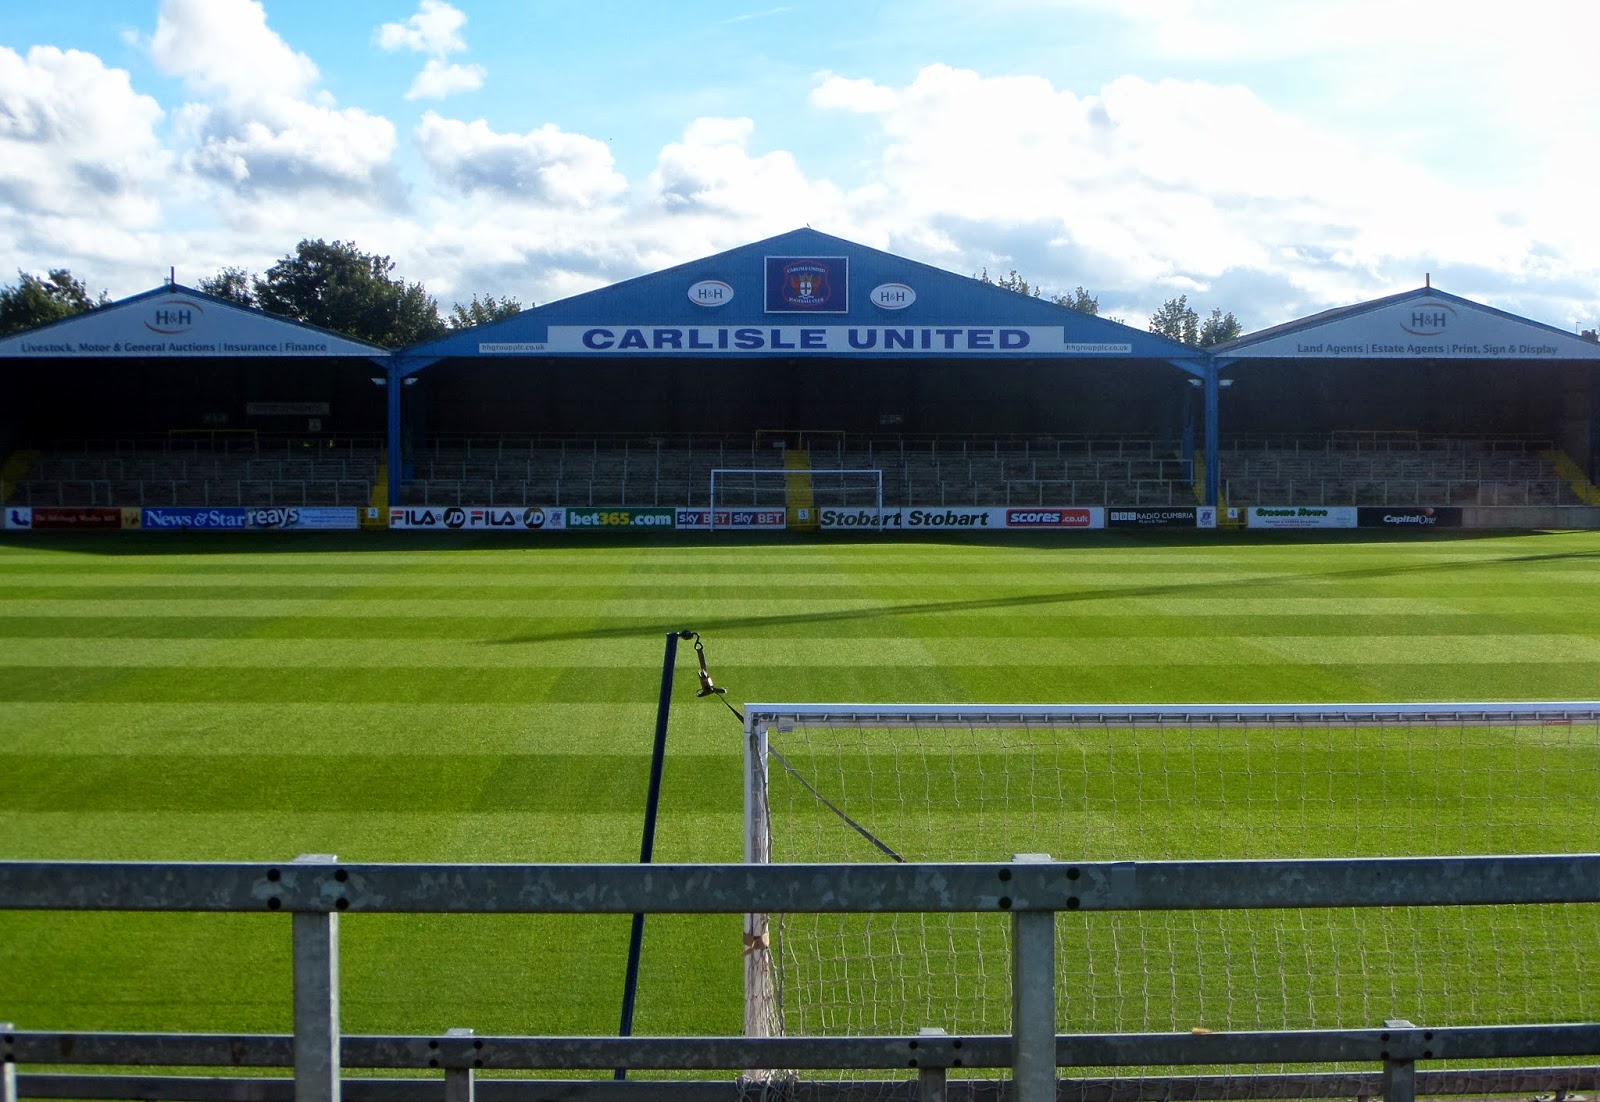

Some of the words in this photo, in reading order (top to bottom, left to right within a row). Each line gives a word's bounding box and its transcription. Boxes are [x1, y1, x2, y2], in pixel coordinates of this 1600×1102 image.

[698, 288, 722, 298] H&H
[881, 291, 905, 301] H&H
[156, 310, 191, 324] H&H
[1411, 312, 1446, 326] H&H
[582, 328, 827, 349] CARLISLE
[848, 328, 1031, 349] UNITED
[21, 343, 76, 352] Livestock,
[79, 343, 110, 352] Motor
[113, 343, 121, 351] &
[125, 343, 165, 351] General
[168, 342, 215, 351] Auctions
[224, 343, 277, 351] Insurance
[285, 342, 327, 351] Finance
[482, 344, 545, 352] hhgroupplc.co.uk
[1066, 344, 1128, 352] hhgroupplc.co.uk
[1297, 344, 1323, 352] Land
[1326, 344, 1363, 354] Agents
[1371, 344, 1404, 352] Estate
[1407, 345, 1444, 354] Agents
[1452, 344, 1480, 354] Print,
[1483, 344, 1505, 355] Sign
[1508, 345, 1516, 353] &
[1519, 345, 1557, 355] Display
[146, 510, 192, 526] News
[194, 512, 208, 526] &
[209, 510, 245, 526] Star
[248, 508, 298, 527] reays
[391, 510, 435, 525] FILA
[446, 511, 464, 525] JD
[471, 510, 515, 525] FILA
[526, 511, 544, 525] JD
[570, 511, 672, 526] bet365.com
[679, 513, 699, 524] sky
[704, 513, 728, 523] BET
[734, 513, 753, 524] sky
[758, 513, 782, 523] BET
[821, 510, 901, 526] Stobart
[908, 510, 990, 526] Stobart
[1136, 511, 1160, 520] RADIO
[1161, 511, 1194, 519] CUMBRIA
